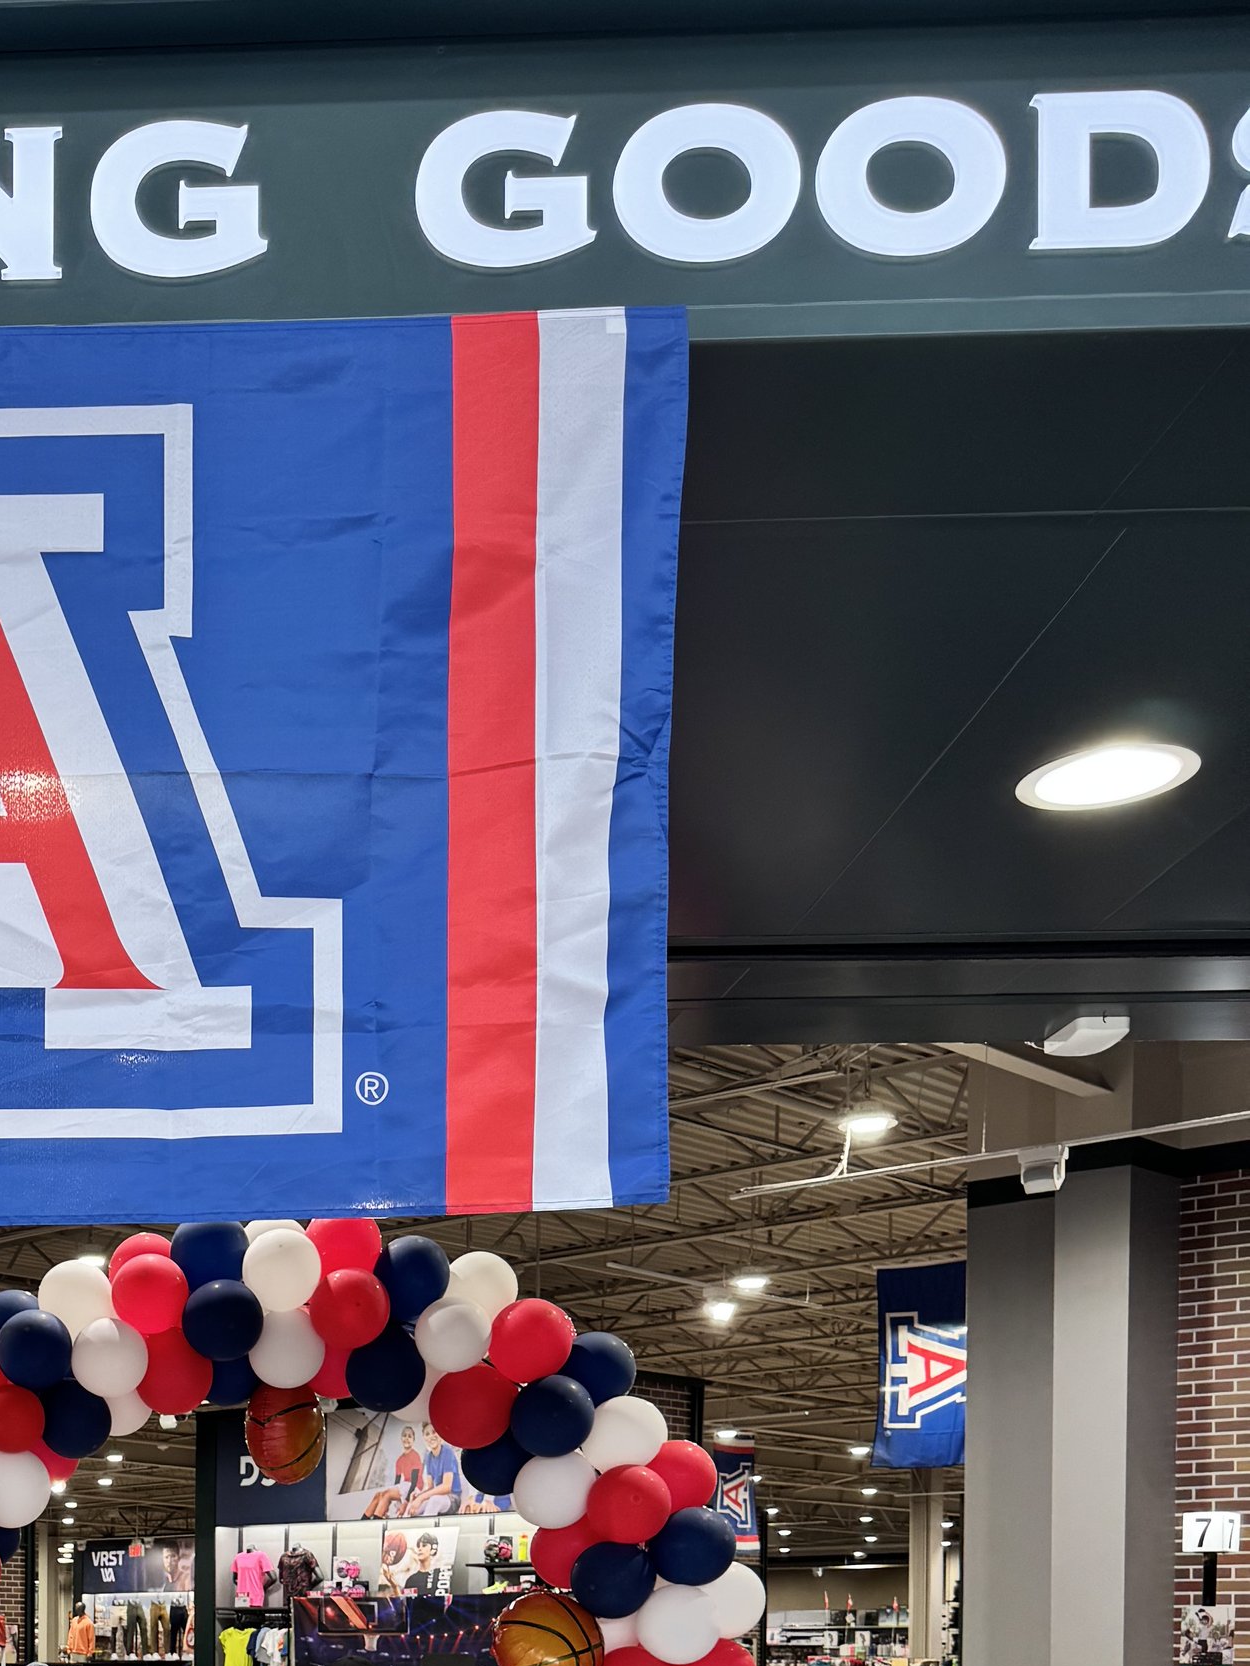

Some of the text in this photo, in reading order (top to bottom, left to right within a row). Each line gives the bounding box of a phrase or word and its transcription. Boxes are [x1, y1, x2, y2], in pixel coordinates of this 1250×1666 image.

[414, 89, 1250, 269] GOOD
[1195, 1518, 1211, 1547] 7
[91, 1550, 125, 1567] VRST
